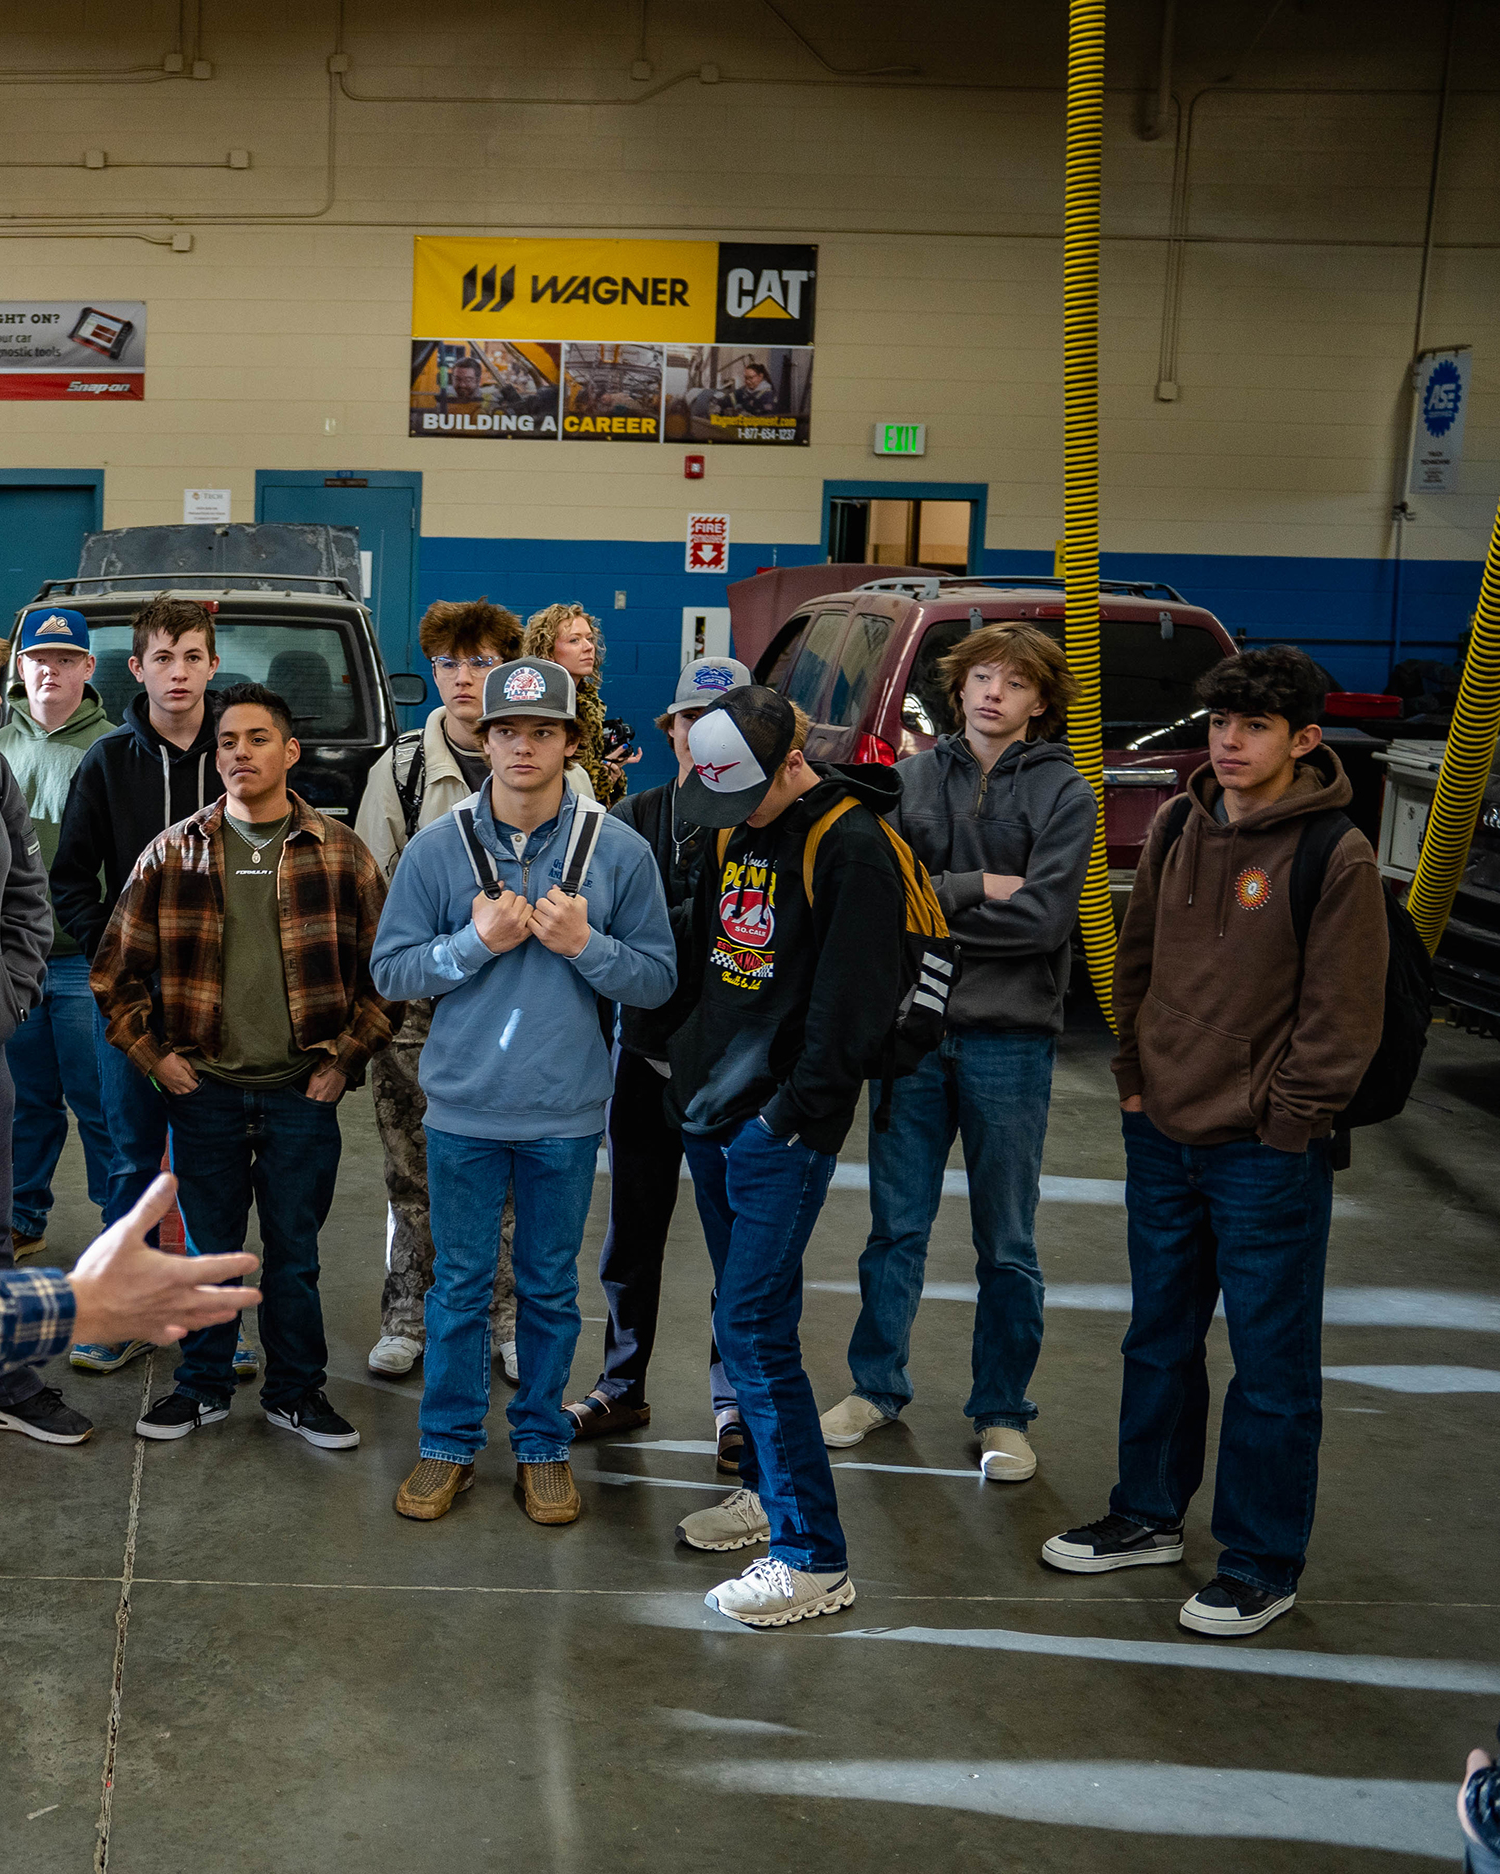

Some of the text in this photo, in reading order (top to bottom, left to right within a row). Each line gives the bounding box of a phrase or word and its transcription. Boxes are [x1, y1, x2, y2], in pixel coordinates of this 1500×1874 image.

[530, 275, 690, 307] WAGNER
[726, 268, 809, 319] CAT
[31, 313, 60, 324] ON?
[16, 335, 32, 343] car
[35, 346, 61, 357] tools
[67, 382, 130, 394] Snap-on
[422, 413, 657, 434] BUILDING A CAREER
[884, 425, 919, 452] EXIT
[695, 523, 723, 533] FIRE
